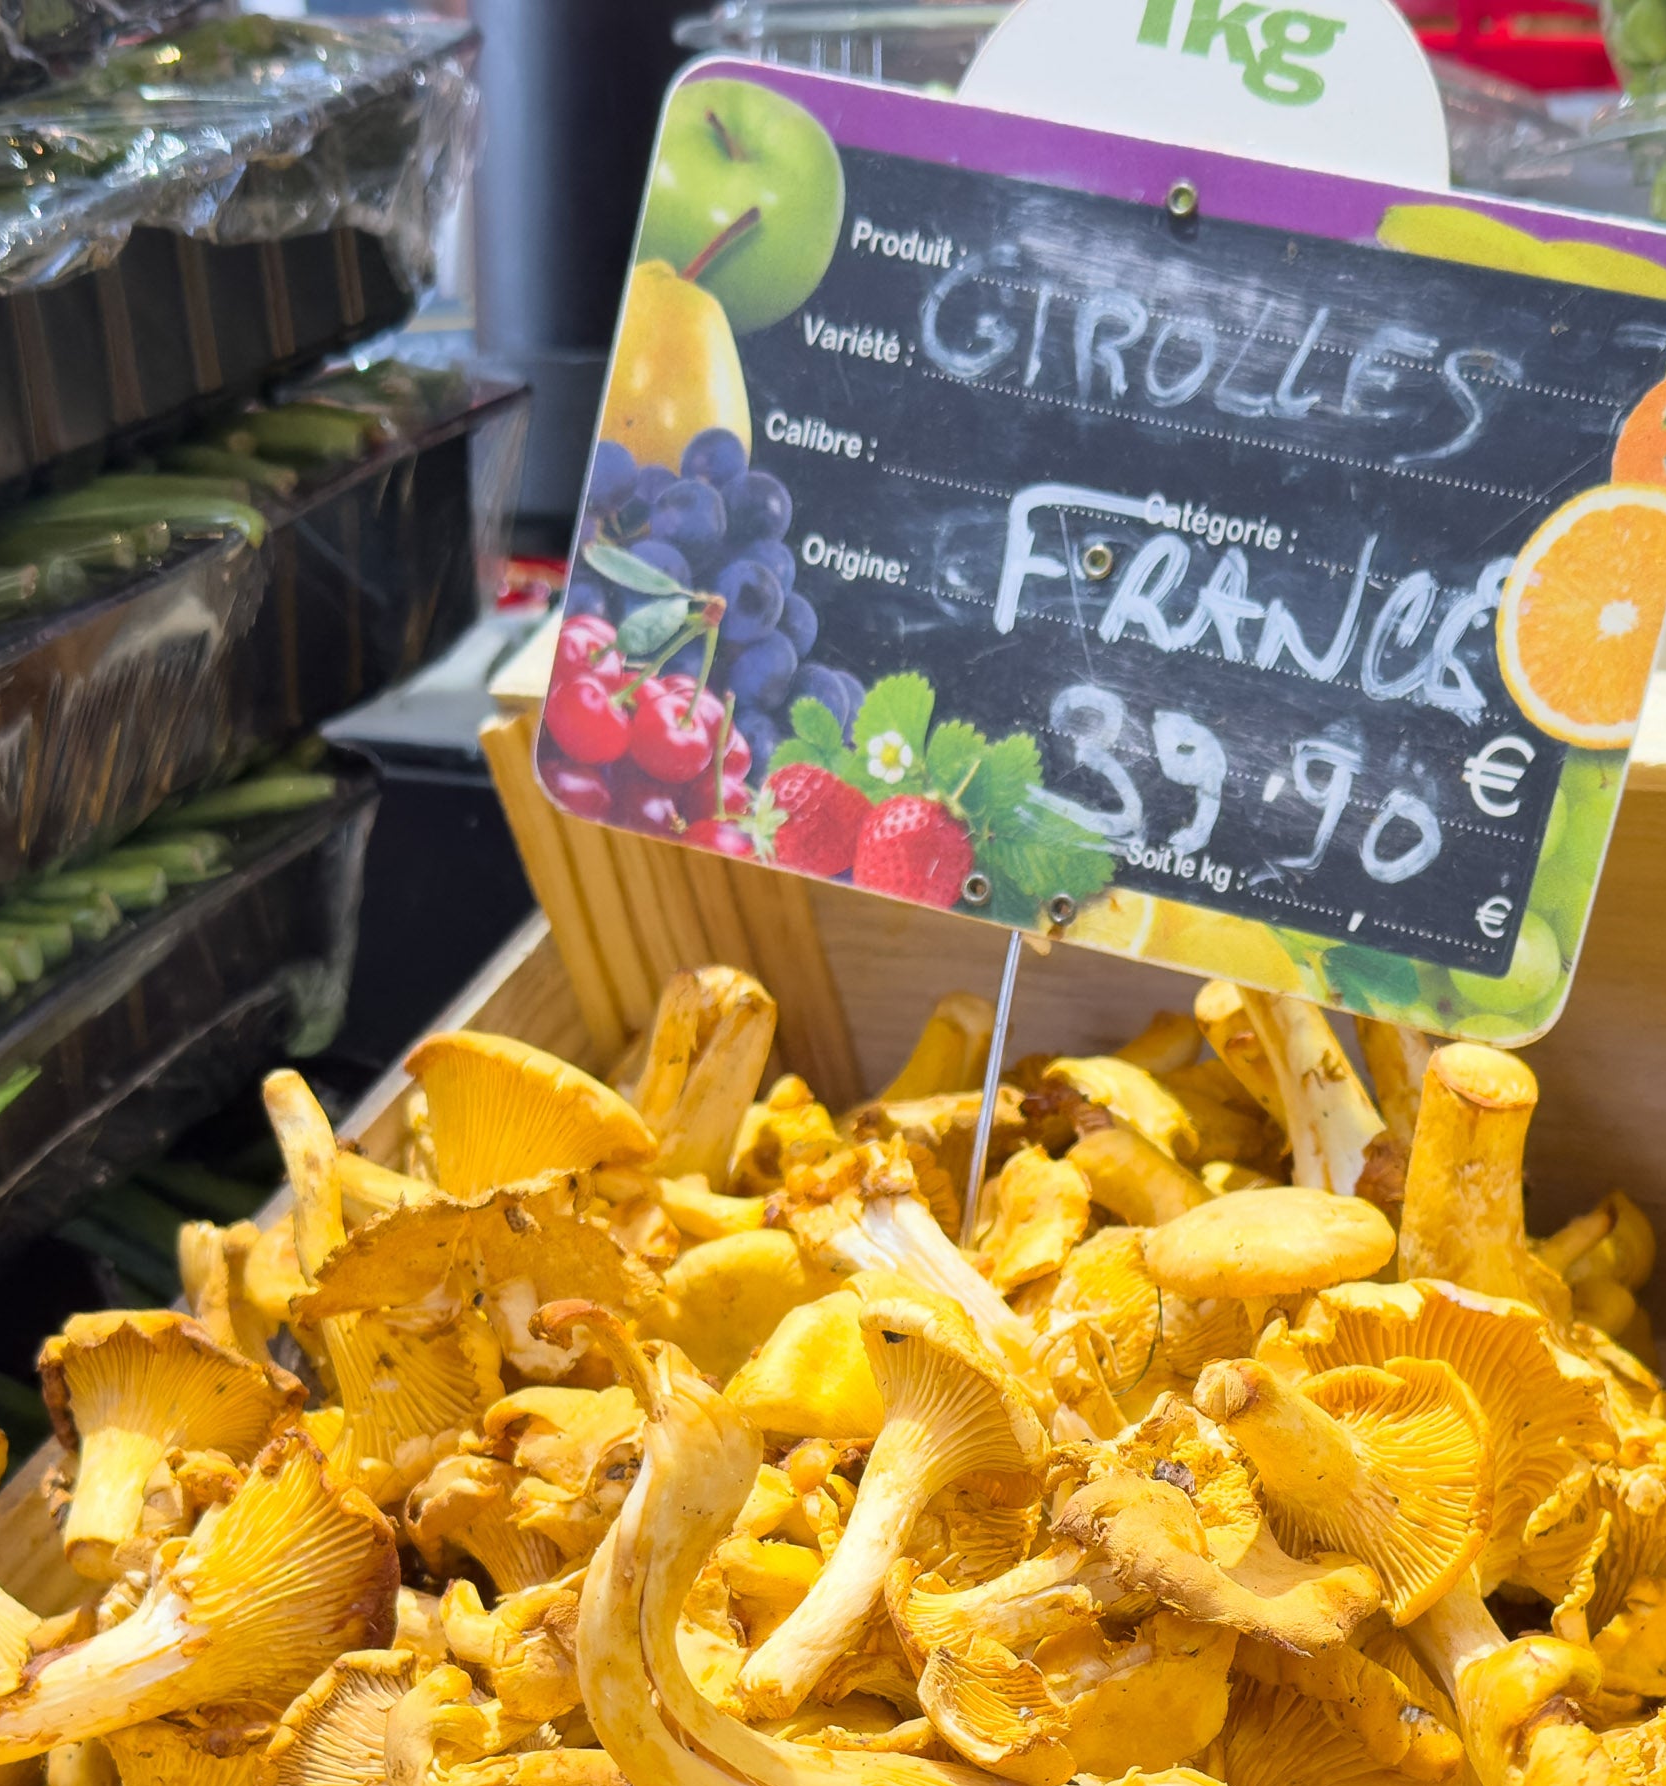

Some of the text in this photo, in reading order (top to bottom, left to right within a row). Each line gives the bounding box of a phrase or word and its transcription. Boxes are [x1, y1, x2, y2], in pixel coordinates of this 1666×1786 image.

[850, 218, 954, 269] Produit
[800, 313, 902, 366] Variété
[919, 244, 1523, 465] GIROLLES
[764, 408, 864, 460] Calibre
[1143, 491, 1284, 551] Catégorie
[993, 482, 1515, 727] FRANCE
[1199, 853, 1234, 893] kg
